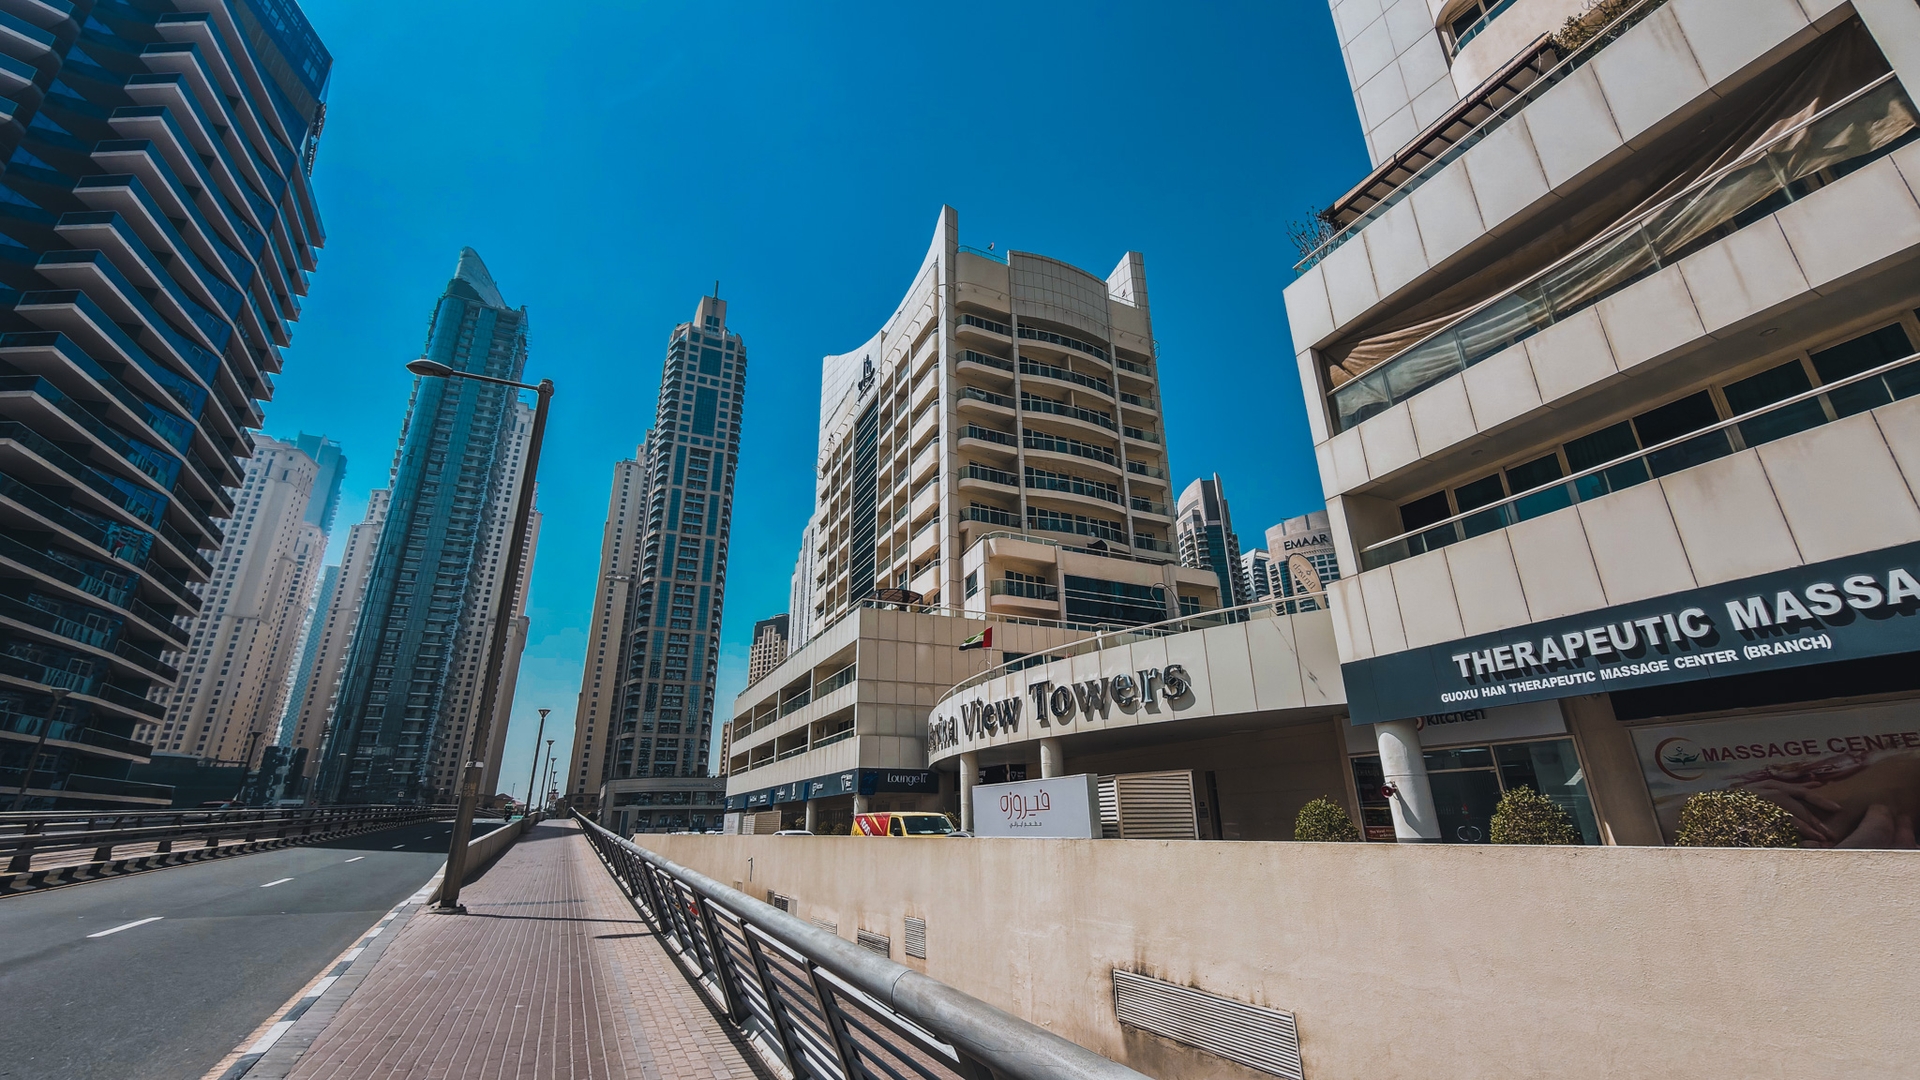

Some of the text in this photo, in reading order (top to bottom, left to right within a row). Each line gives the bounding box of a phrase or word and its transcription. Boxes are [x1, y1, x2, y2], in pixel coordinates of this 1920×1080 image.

[1284, 534, 1329, 550] EMAAR
[1441, 633, 1832, 703] GUOXU HAN THERAPEUTIC MASSAGE CENTER (BRANCH)
[1452, 607, 1711, 678] THERAPEUTIC
[960, 696, 1020, 733] View
[1028, 664, 1187, 721] Towers
[1702, 739, 1821, 762] MASSAGE
